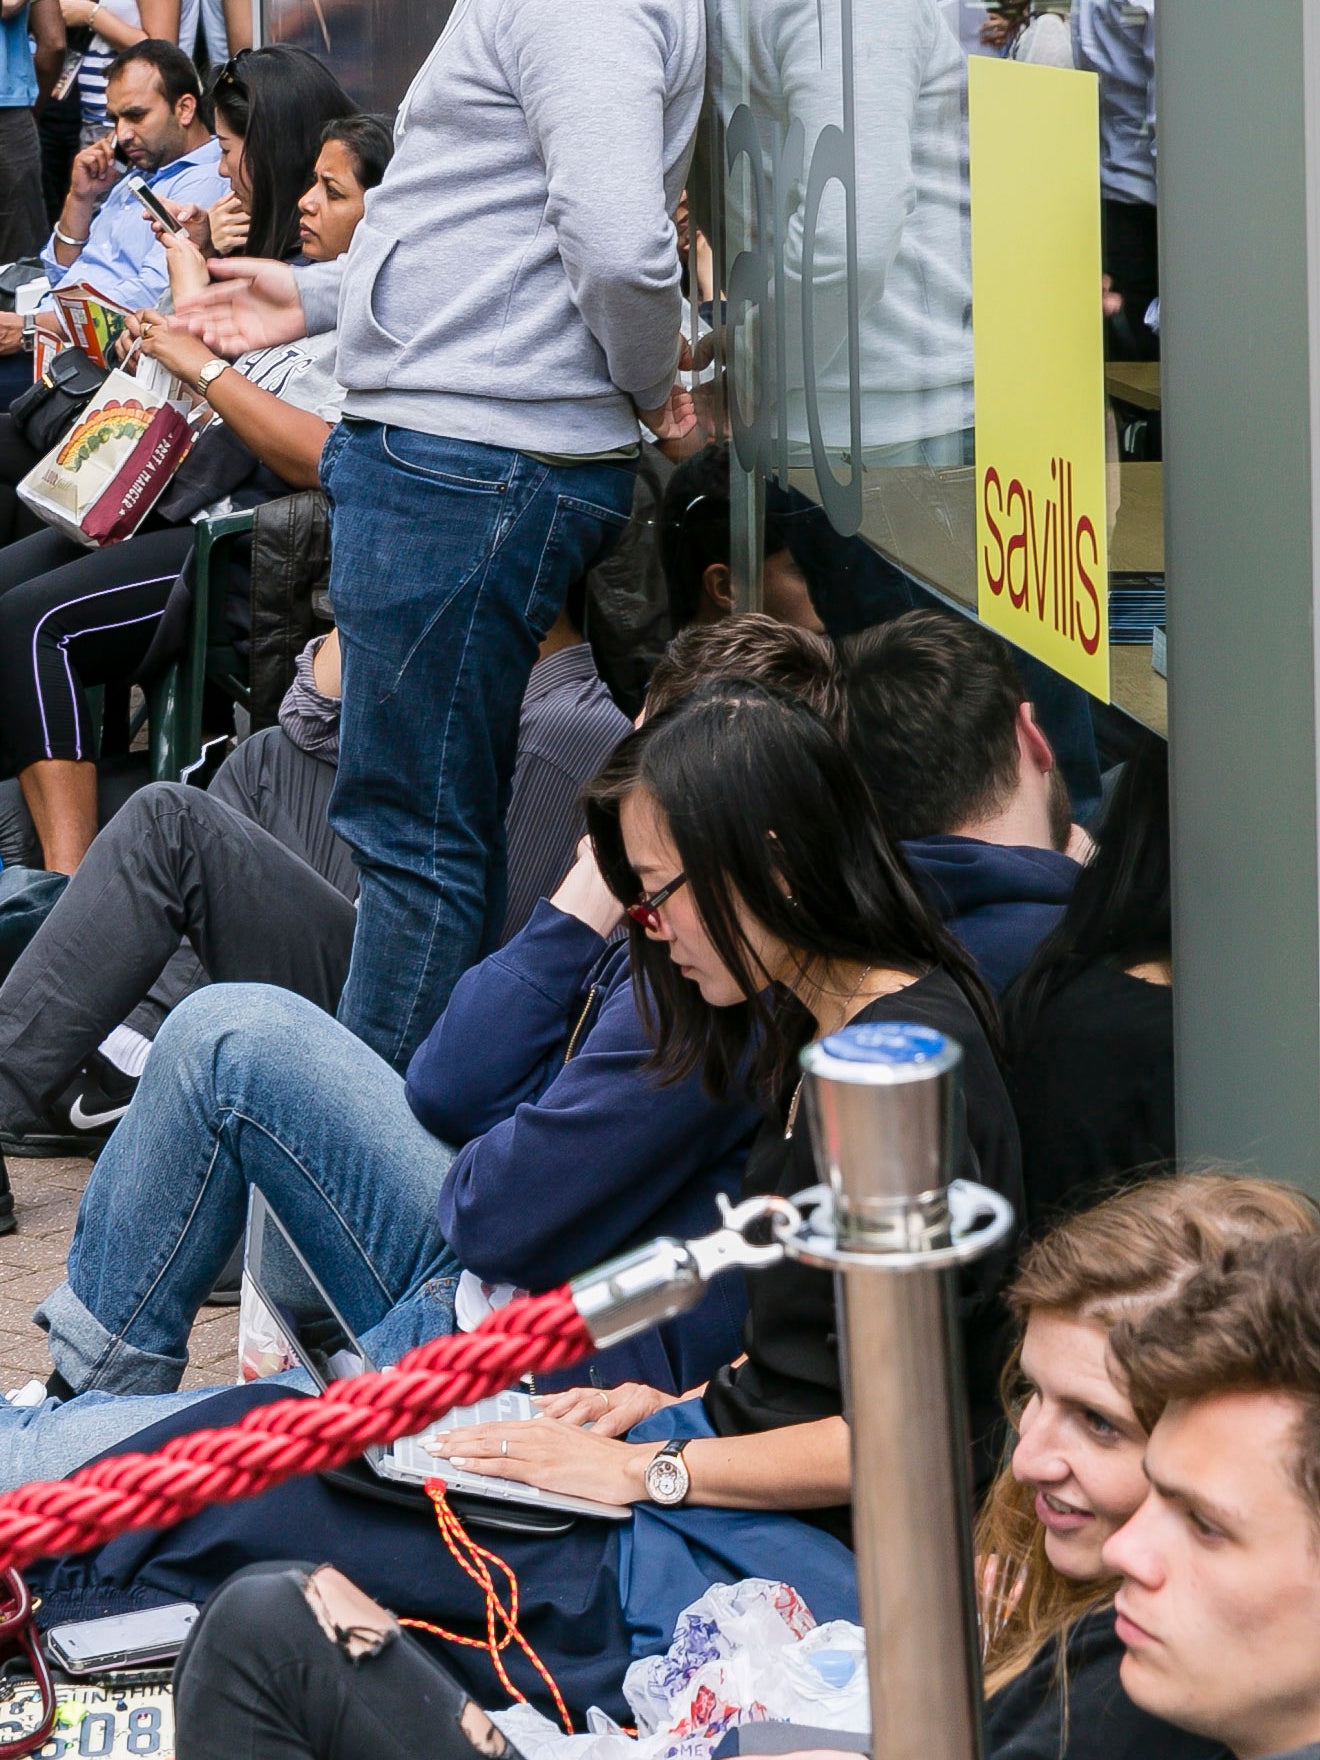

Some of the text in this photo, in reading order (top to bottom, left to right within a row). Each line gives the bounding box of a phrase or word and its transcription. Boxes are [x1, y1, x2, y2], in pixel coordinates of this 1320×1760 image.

[121, 438, 172, 509] PRET A MANGER
[983, 456, 1101, 656] savills
